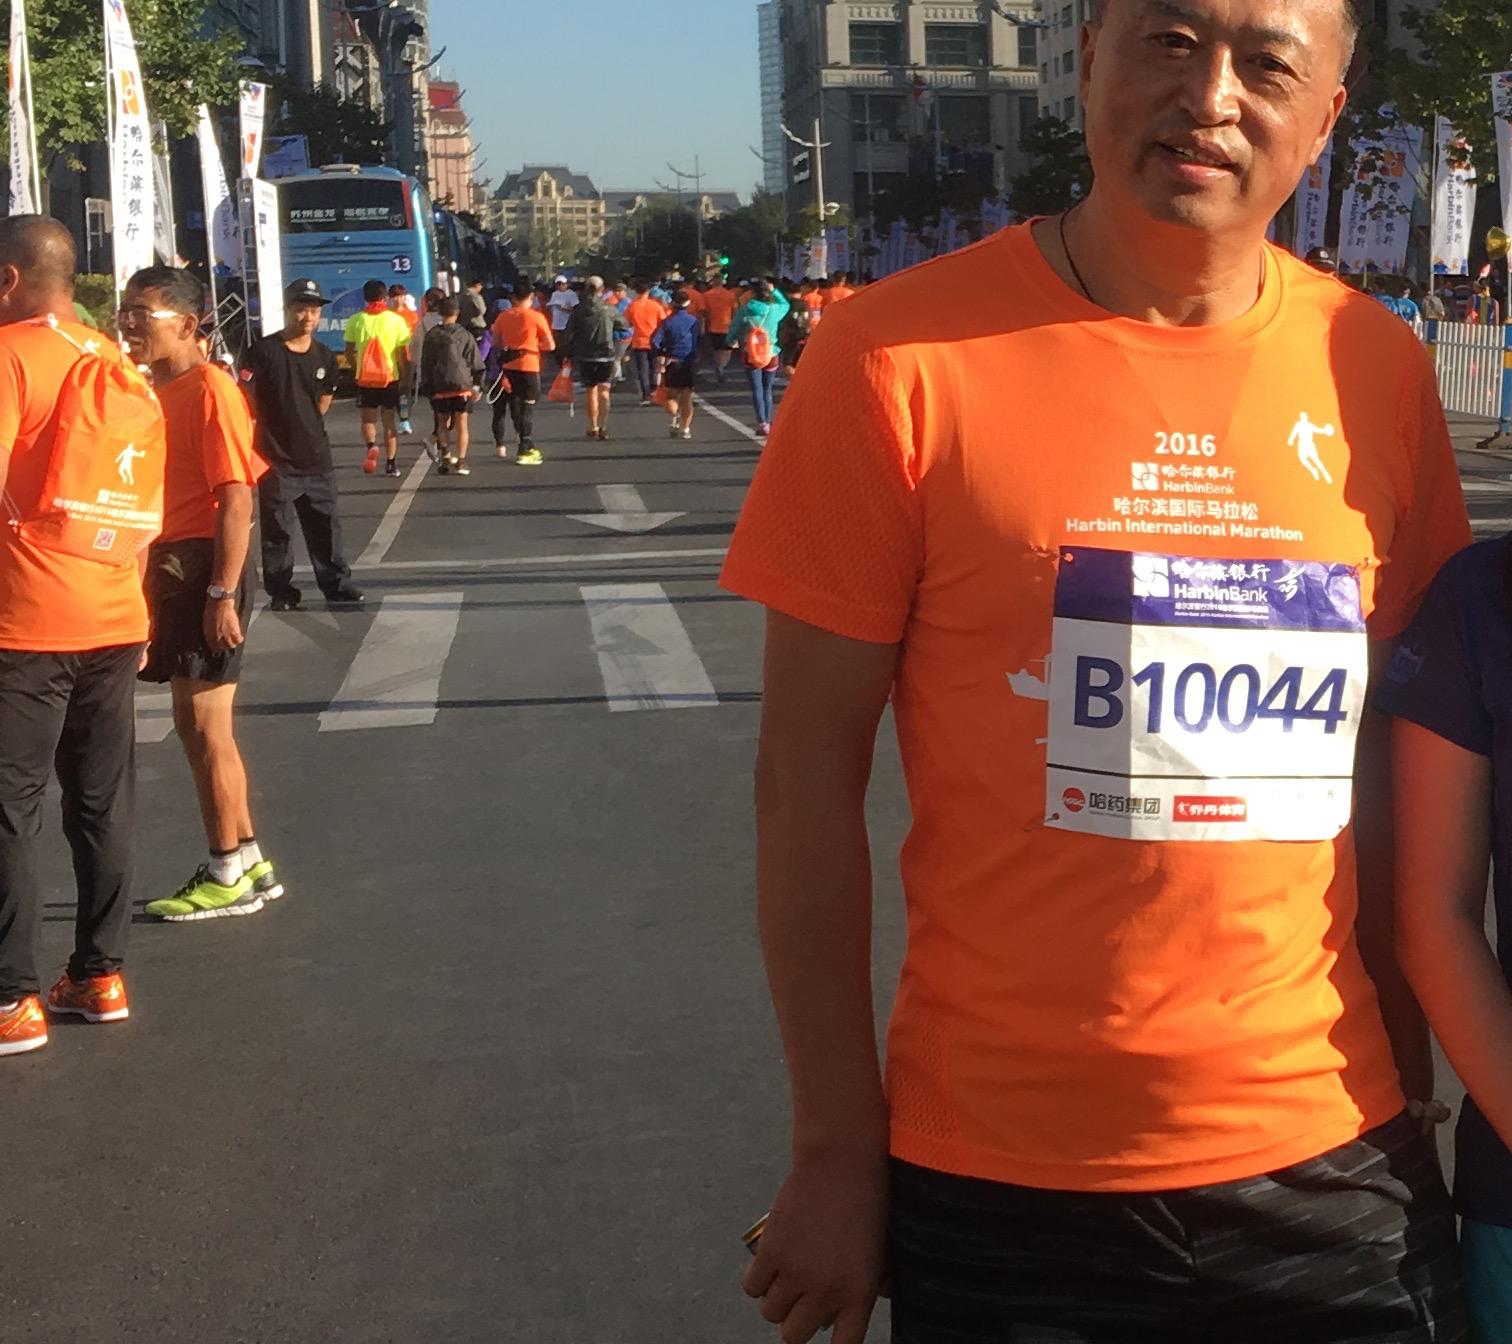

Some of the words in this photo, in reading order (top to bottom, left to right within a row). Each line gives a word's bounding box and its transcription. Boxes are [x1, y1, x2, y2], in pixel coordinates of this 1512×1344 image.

[392, 258, 411, 271] 13
[1155, 432, 1216, 456] 2016
[1163, 481, 1235, 495] HarbinBank
[1113, 497, 1258, 522] 哈尔滨国际马拉松
[1066, 518, 1122, 533] Harbin
[1126, 519, 1226, 536] International
[1230, 525, 1303, 542] Marathon
[1174, 584, 1268, 603] HarbinBank
[1074, 655, 1348, 734] B10044
[1089, 792, 1161, 815] 哈药集团
